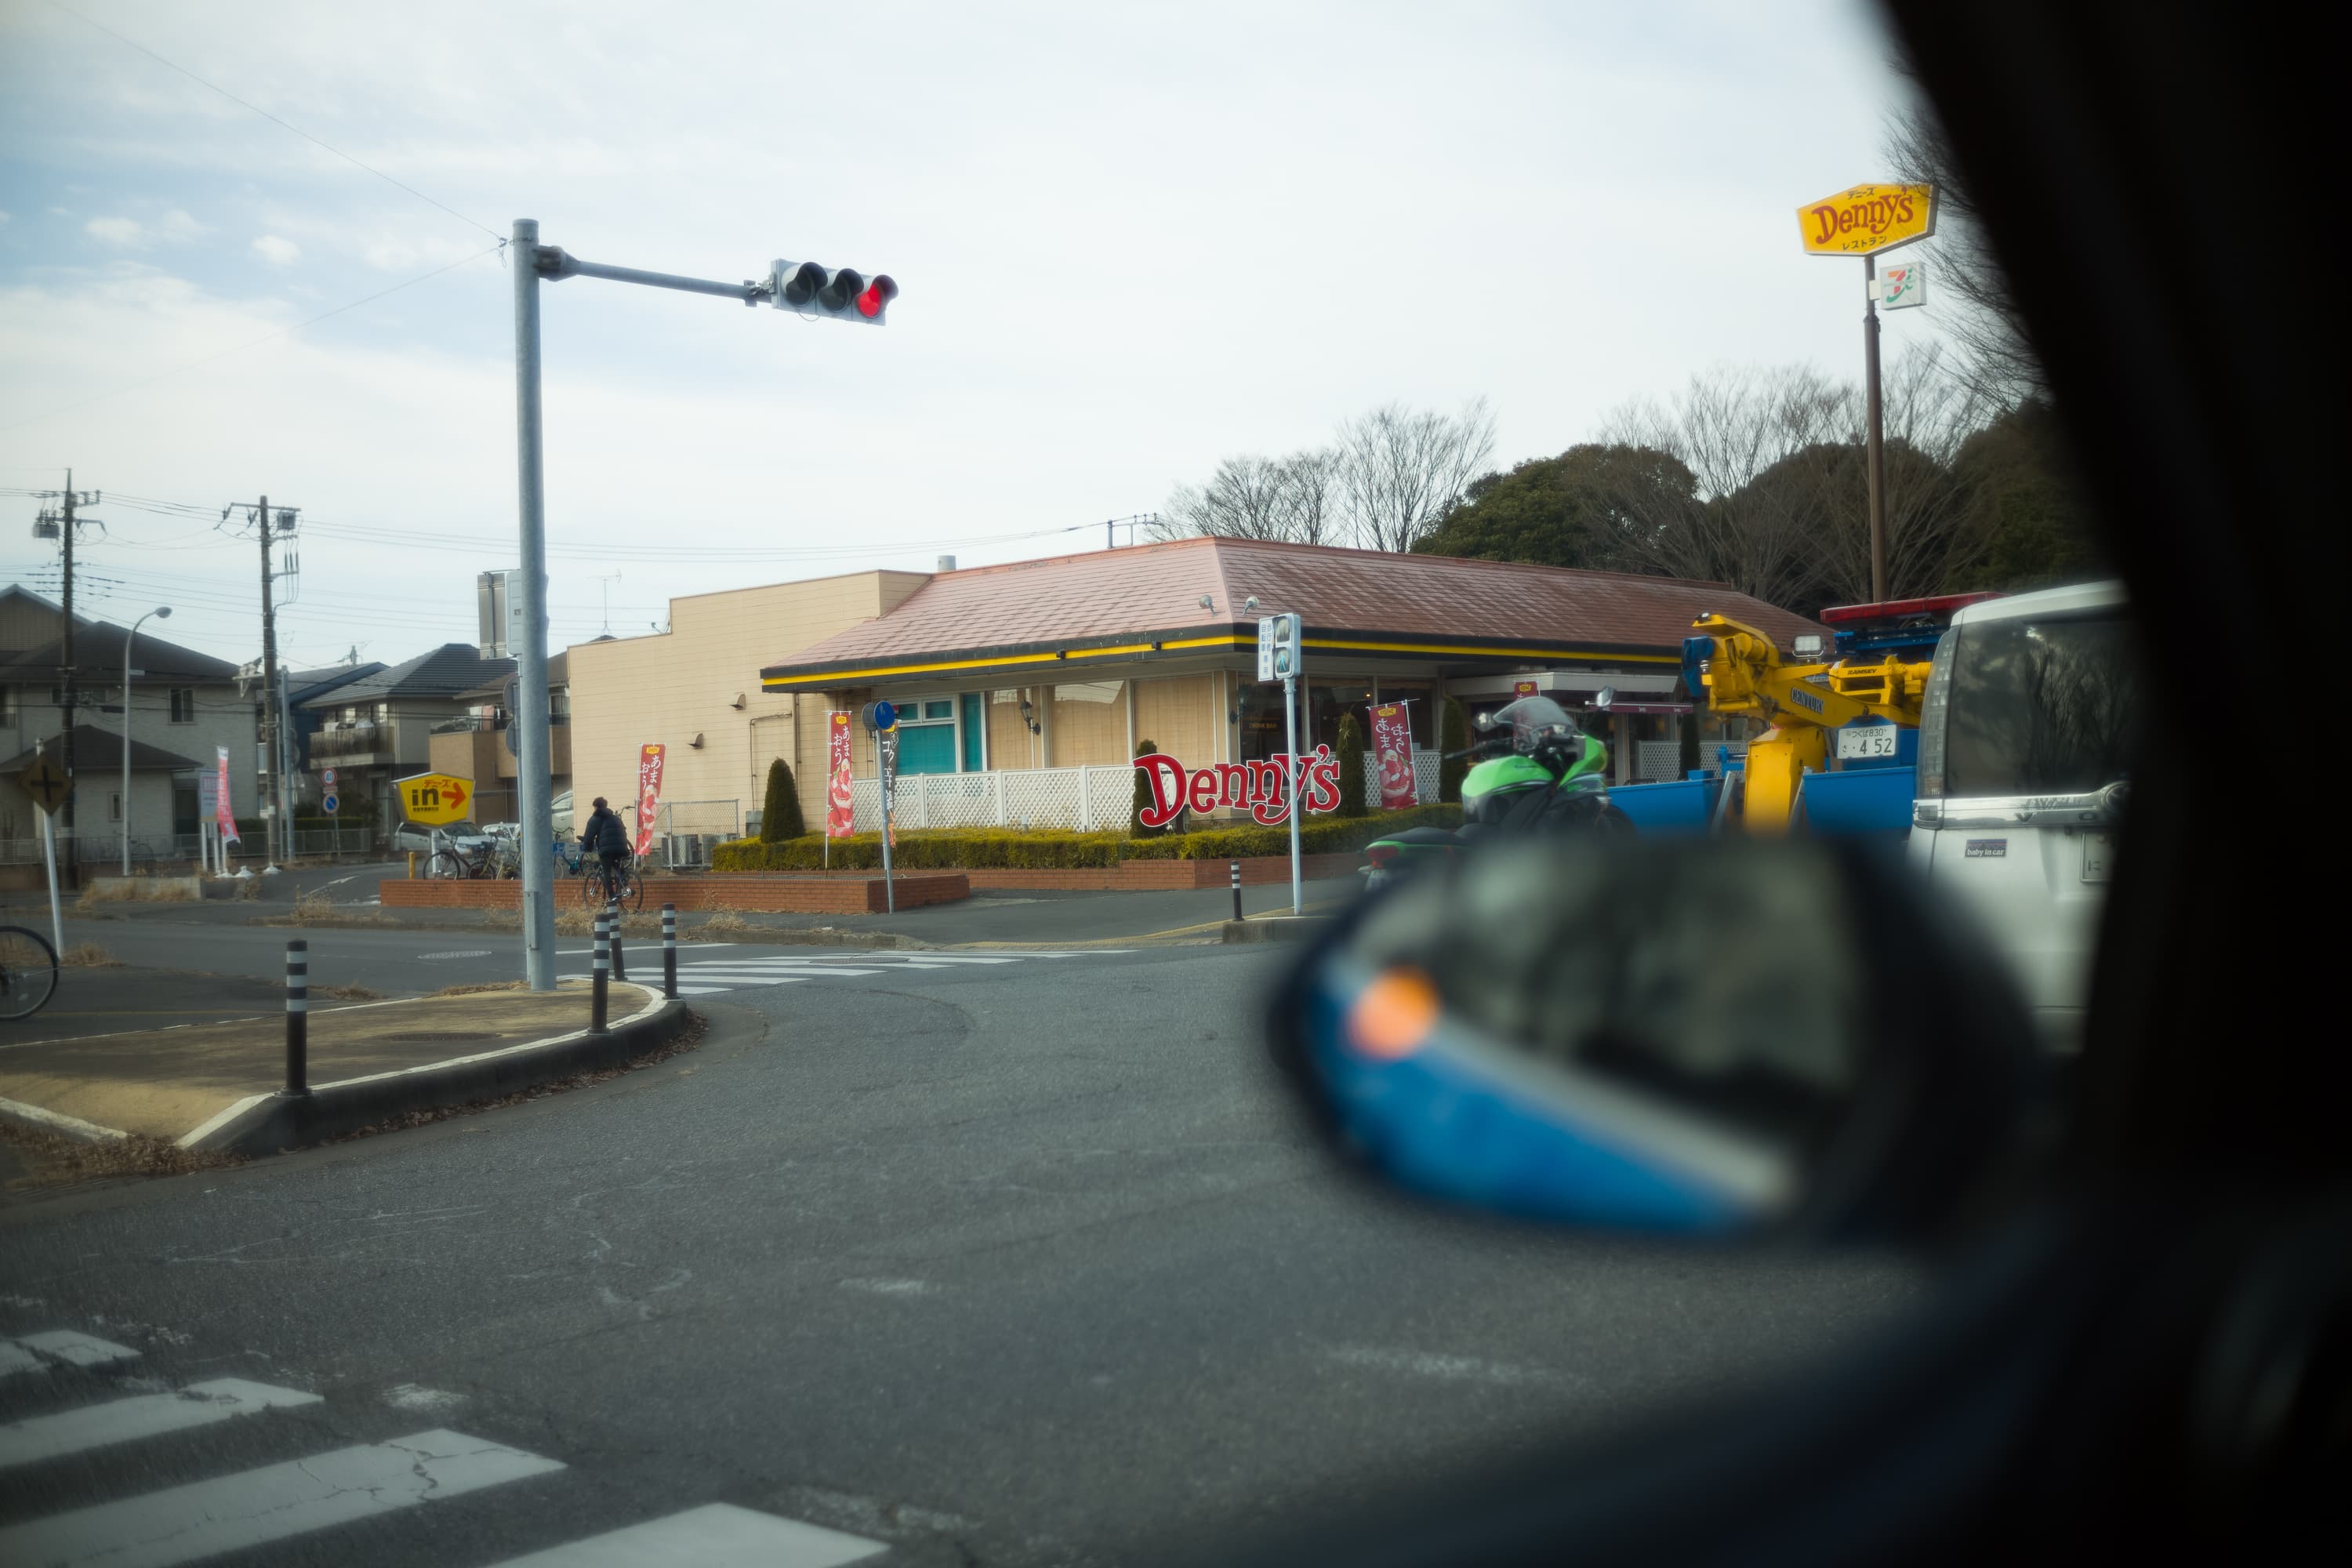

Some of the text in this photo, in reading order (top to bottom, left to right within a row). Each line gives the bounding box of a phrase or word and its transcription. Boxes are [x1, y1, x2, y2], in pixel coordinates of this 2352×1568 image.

[1847, 187, 1878, 200] デニーズ
[1811, 186, 1914, 245] Denny's
[1842, 235, 1887, 251] レストラン
[1791, 688, 1824, 714] CENTURY
[833, 733, 843, 764] おう
[842, 725, 851, 757] あま
[641, 761, 650, 791] おう
[650, 755, 661, 783] あま
[412, 788, 439, 807] in
[1133, 743, 1341, 827] Denny's
[1966, 848, 1984, 857] baby
